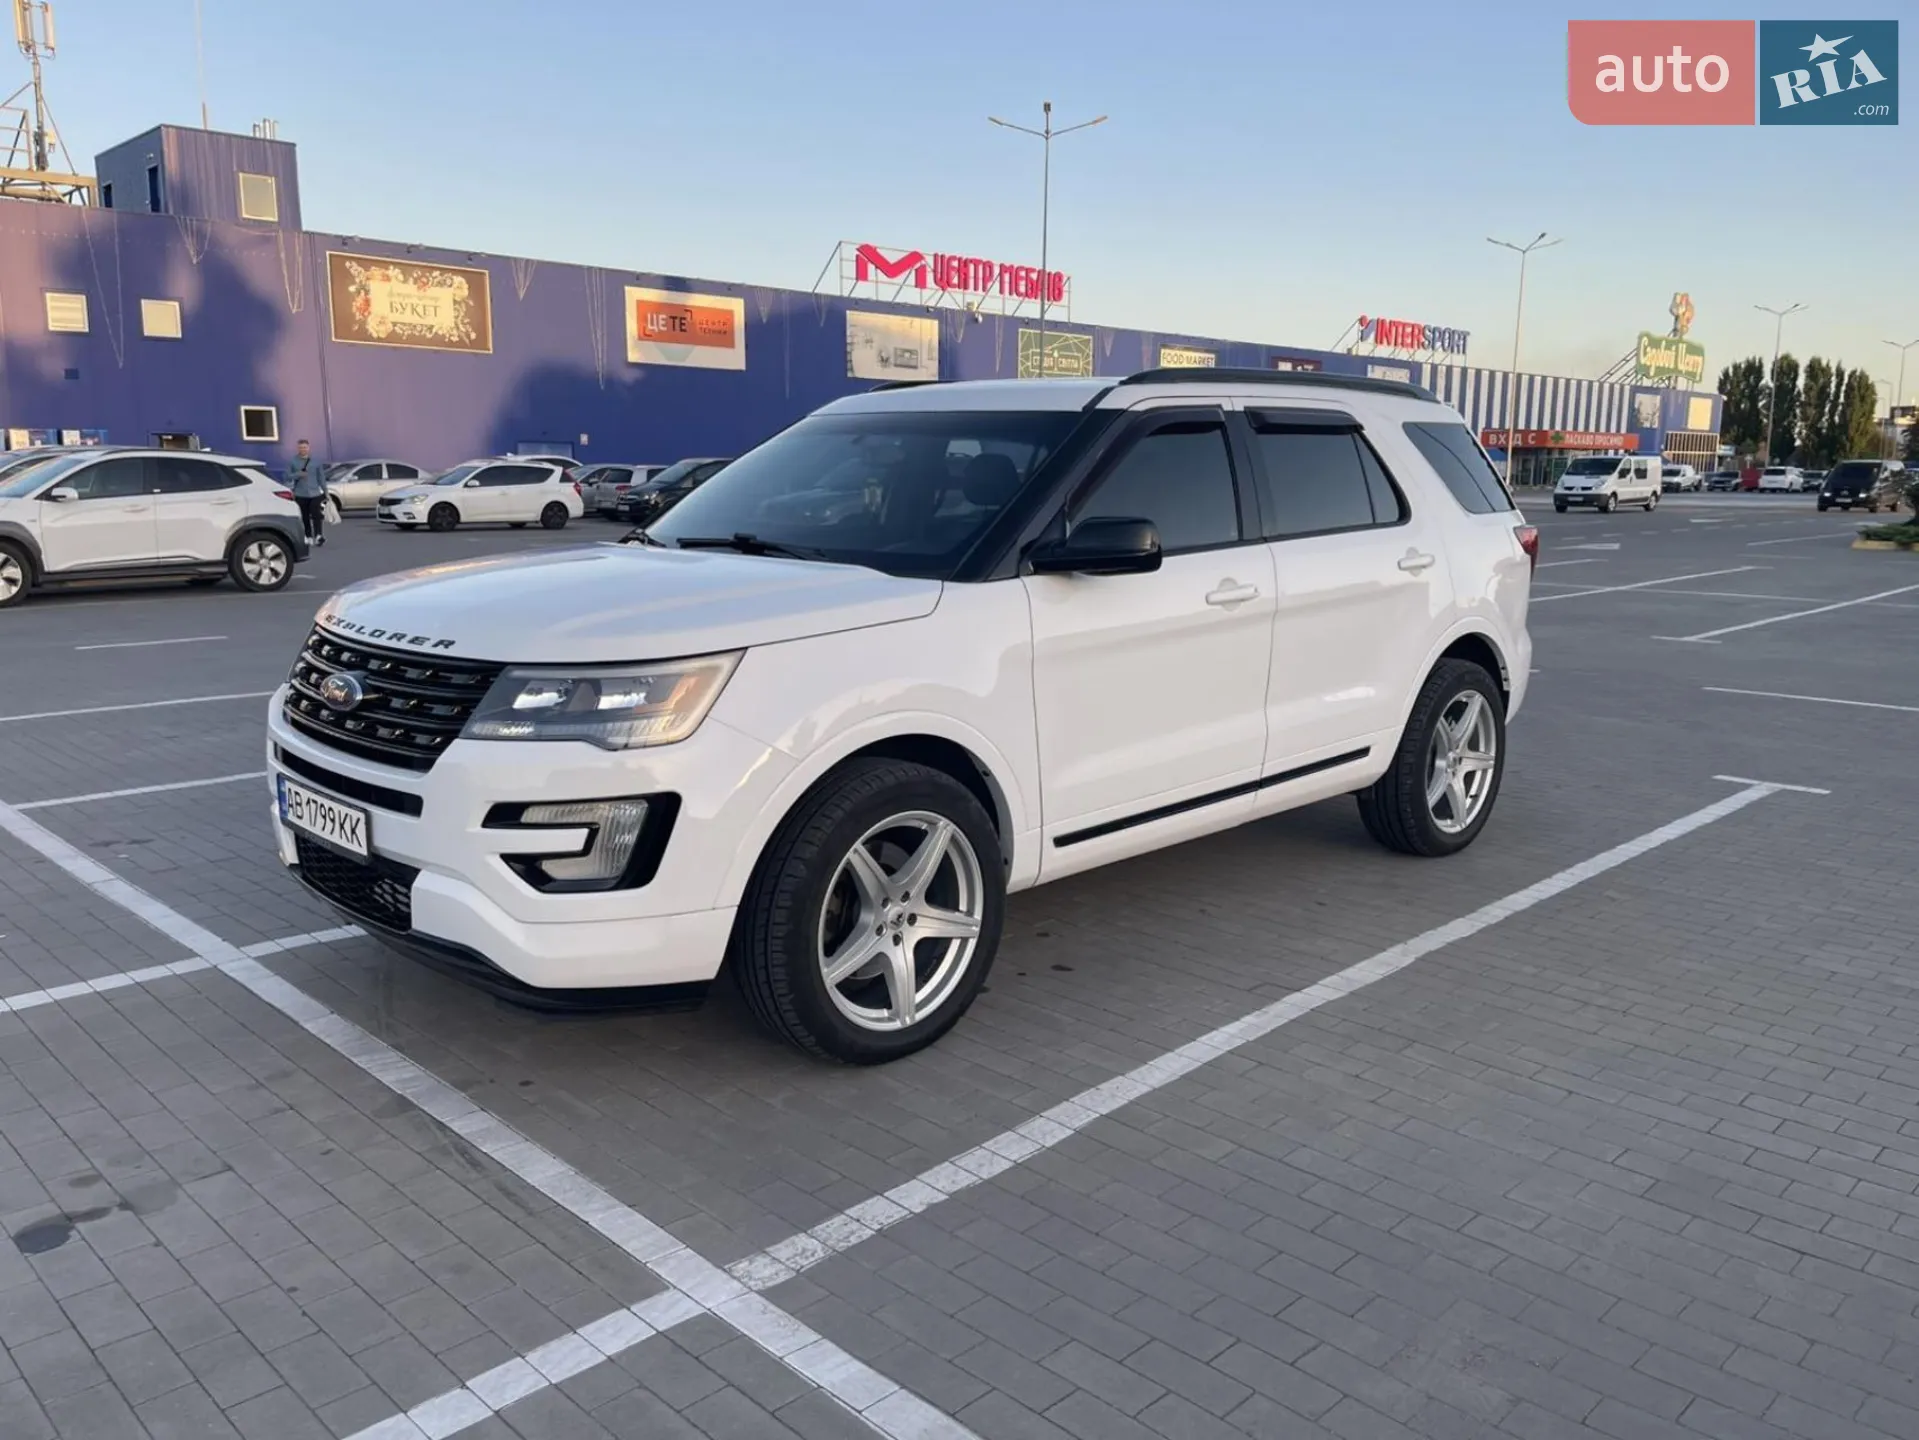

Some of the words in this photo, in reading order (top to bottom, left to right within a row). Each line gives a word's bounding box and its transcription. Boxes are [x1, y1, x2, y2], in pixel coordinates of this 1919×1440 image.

[933, 252, 994, 292] ЦЕНТР
[999, 262, 1064, 302] МЕБЛІВ
[389, 300, 442, 319] БУКЕТ
[1375, 318, 1471, 355] INTERSPORT
[1162, 353, 1184, 364] FOOD
[1186, 355, 1215, 367] MARKET
[1488, 433, 1523, 447] ВХД
[1565, 434, 1594, 445] ЛАСКАВО
[1594, 435, 1624, 446] ПРОСИМО
[325, 613, 457, 649] EXPLORER
